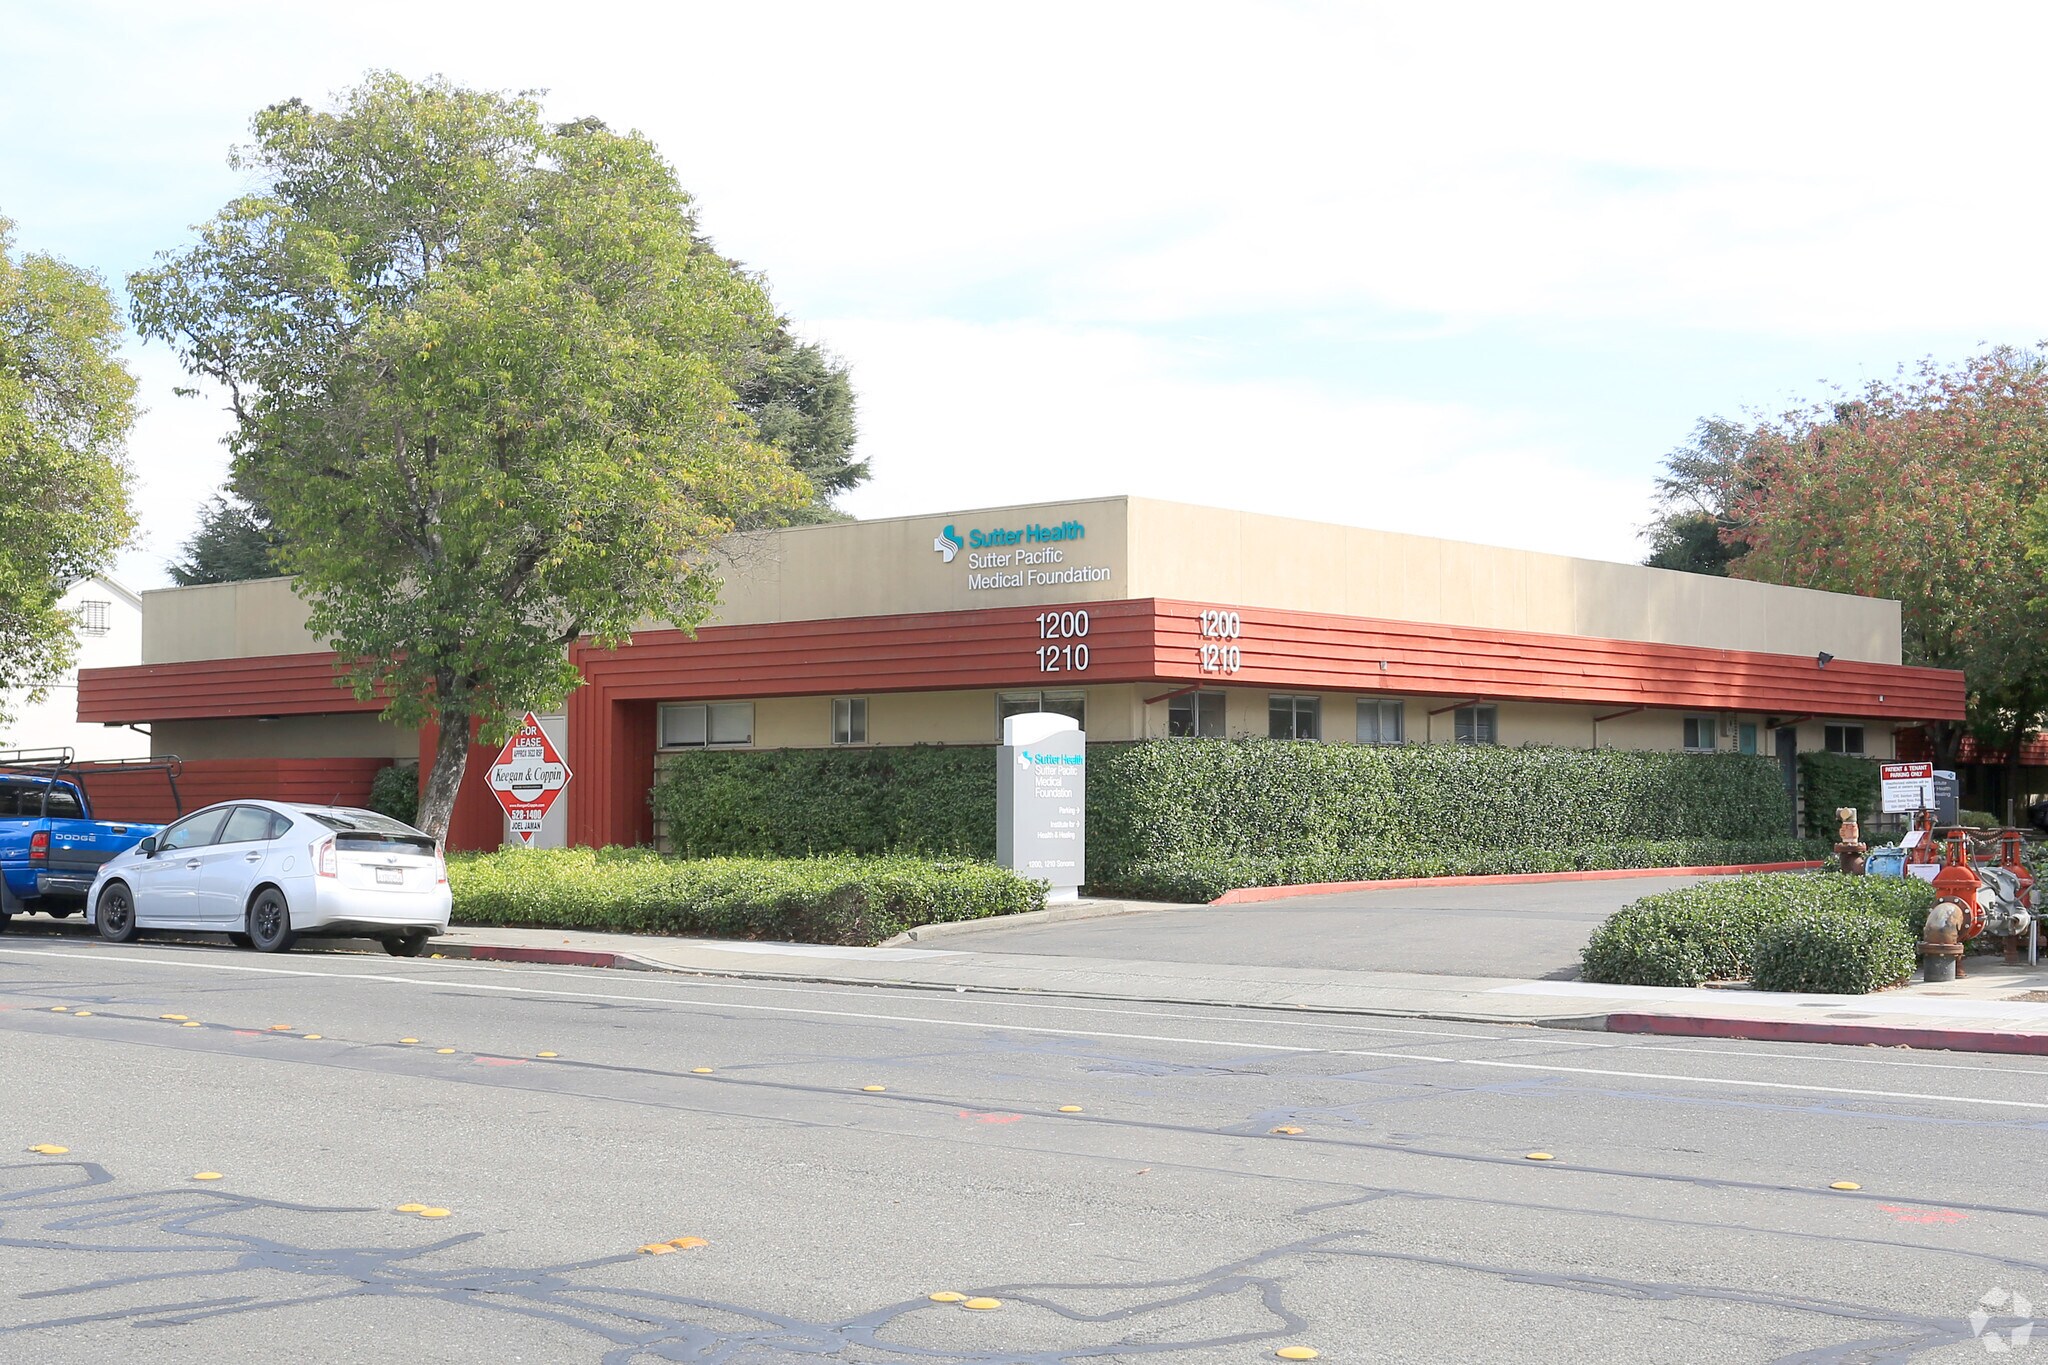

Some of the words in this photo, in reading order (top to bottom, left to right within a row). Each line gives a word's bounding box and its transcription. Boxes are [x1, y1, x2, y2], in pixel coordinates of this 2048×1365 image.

[969, 526, 1024, 549] Sutter
[1026, 520, 1085, 543] Health
[968, 551, 1011, 570] Sutter
[1015, 547, 1064, 566] Pacific
[968, 570, 1023, 590] Medical
[1027, 566, 1111, 586] Foundation
[1036, 610, 1090, 639] 1200
[1200, 609, 1240, 639] 1200
[1036, 644, 1089, 673] 1210
[1200, 643, 1240, 673] 1210
[520, 726, 537, 736] FOR
[515, 738, 542, 748] LEASE
[1034, 753, 1059, 765] Sutter
[1061, 754, 1084, 765] Health
[495, 768, 523, 784] Keegan
[524, 767, 533, 781] &
[534, 766, 562, 783] Coppin
[1034, 765, 1057, 776] Sutter
[1058, 765, 1078, 776] Pacific
[1035, 776, 1062, 787] Medical
[1035, 787, 1073, 798] Foundation
[511, 809, 542, 820] 528-1400
[1058, 806, 1076, 815] Parking
[511, 822, 524, 830] JOEL
[524, 821, 541, 830] JAMAN
[1050, 820, 1068, 828] Institute
[55, 833, 97, 842] DODGE
[1037, 831, 1053, 839] Health
[1058, 831, 1076, 840] Healing
